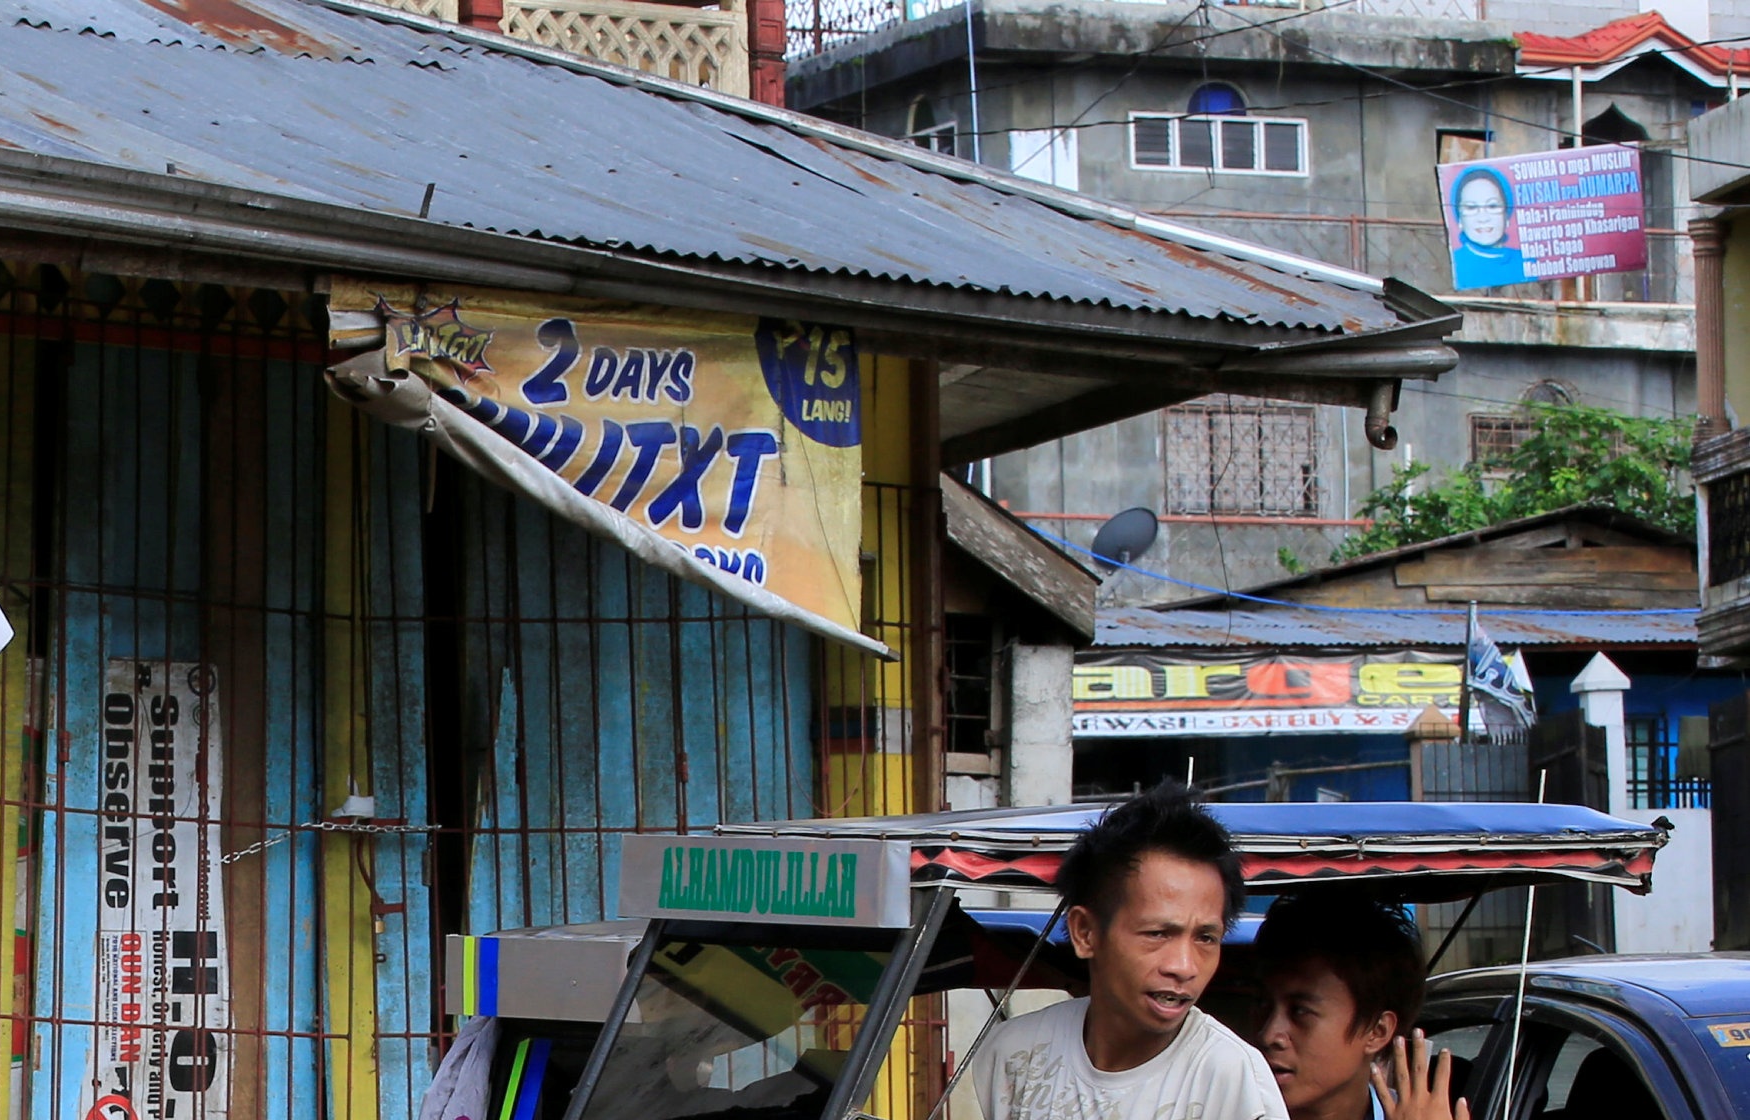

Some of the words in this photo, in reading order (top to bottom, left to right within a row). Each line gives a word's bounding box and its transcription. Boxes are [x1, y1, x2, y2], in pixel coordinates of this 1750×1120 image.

[1515, 180, 1560, 204] FAYSAH
[1579, 171, 1638, 197] DUMARPA
[1568, 157, 1590, 176] mga
[1565, 221, 1583, 239] ago
[522, 318, 581, 405] 2
[585, 347, 694, 402] DAYS
[802, 400, 852, 423] LANG!
[104, 693, 134, 908] Observe
[149, 695, 179, 910] Support
[658, 846, 858, 918] ALHAMDULILLAH
